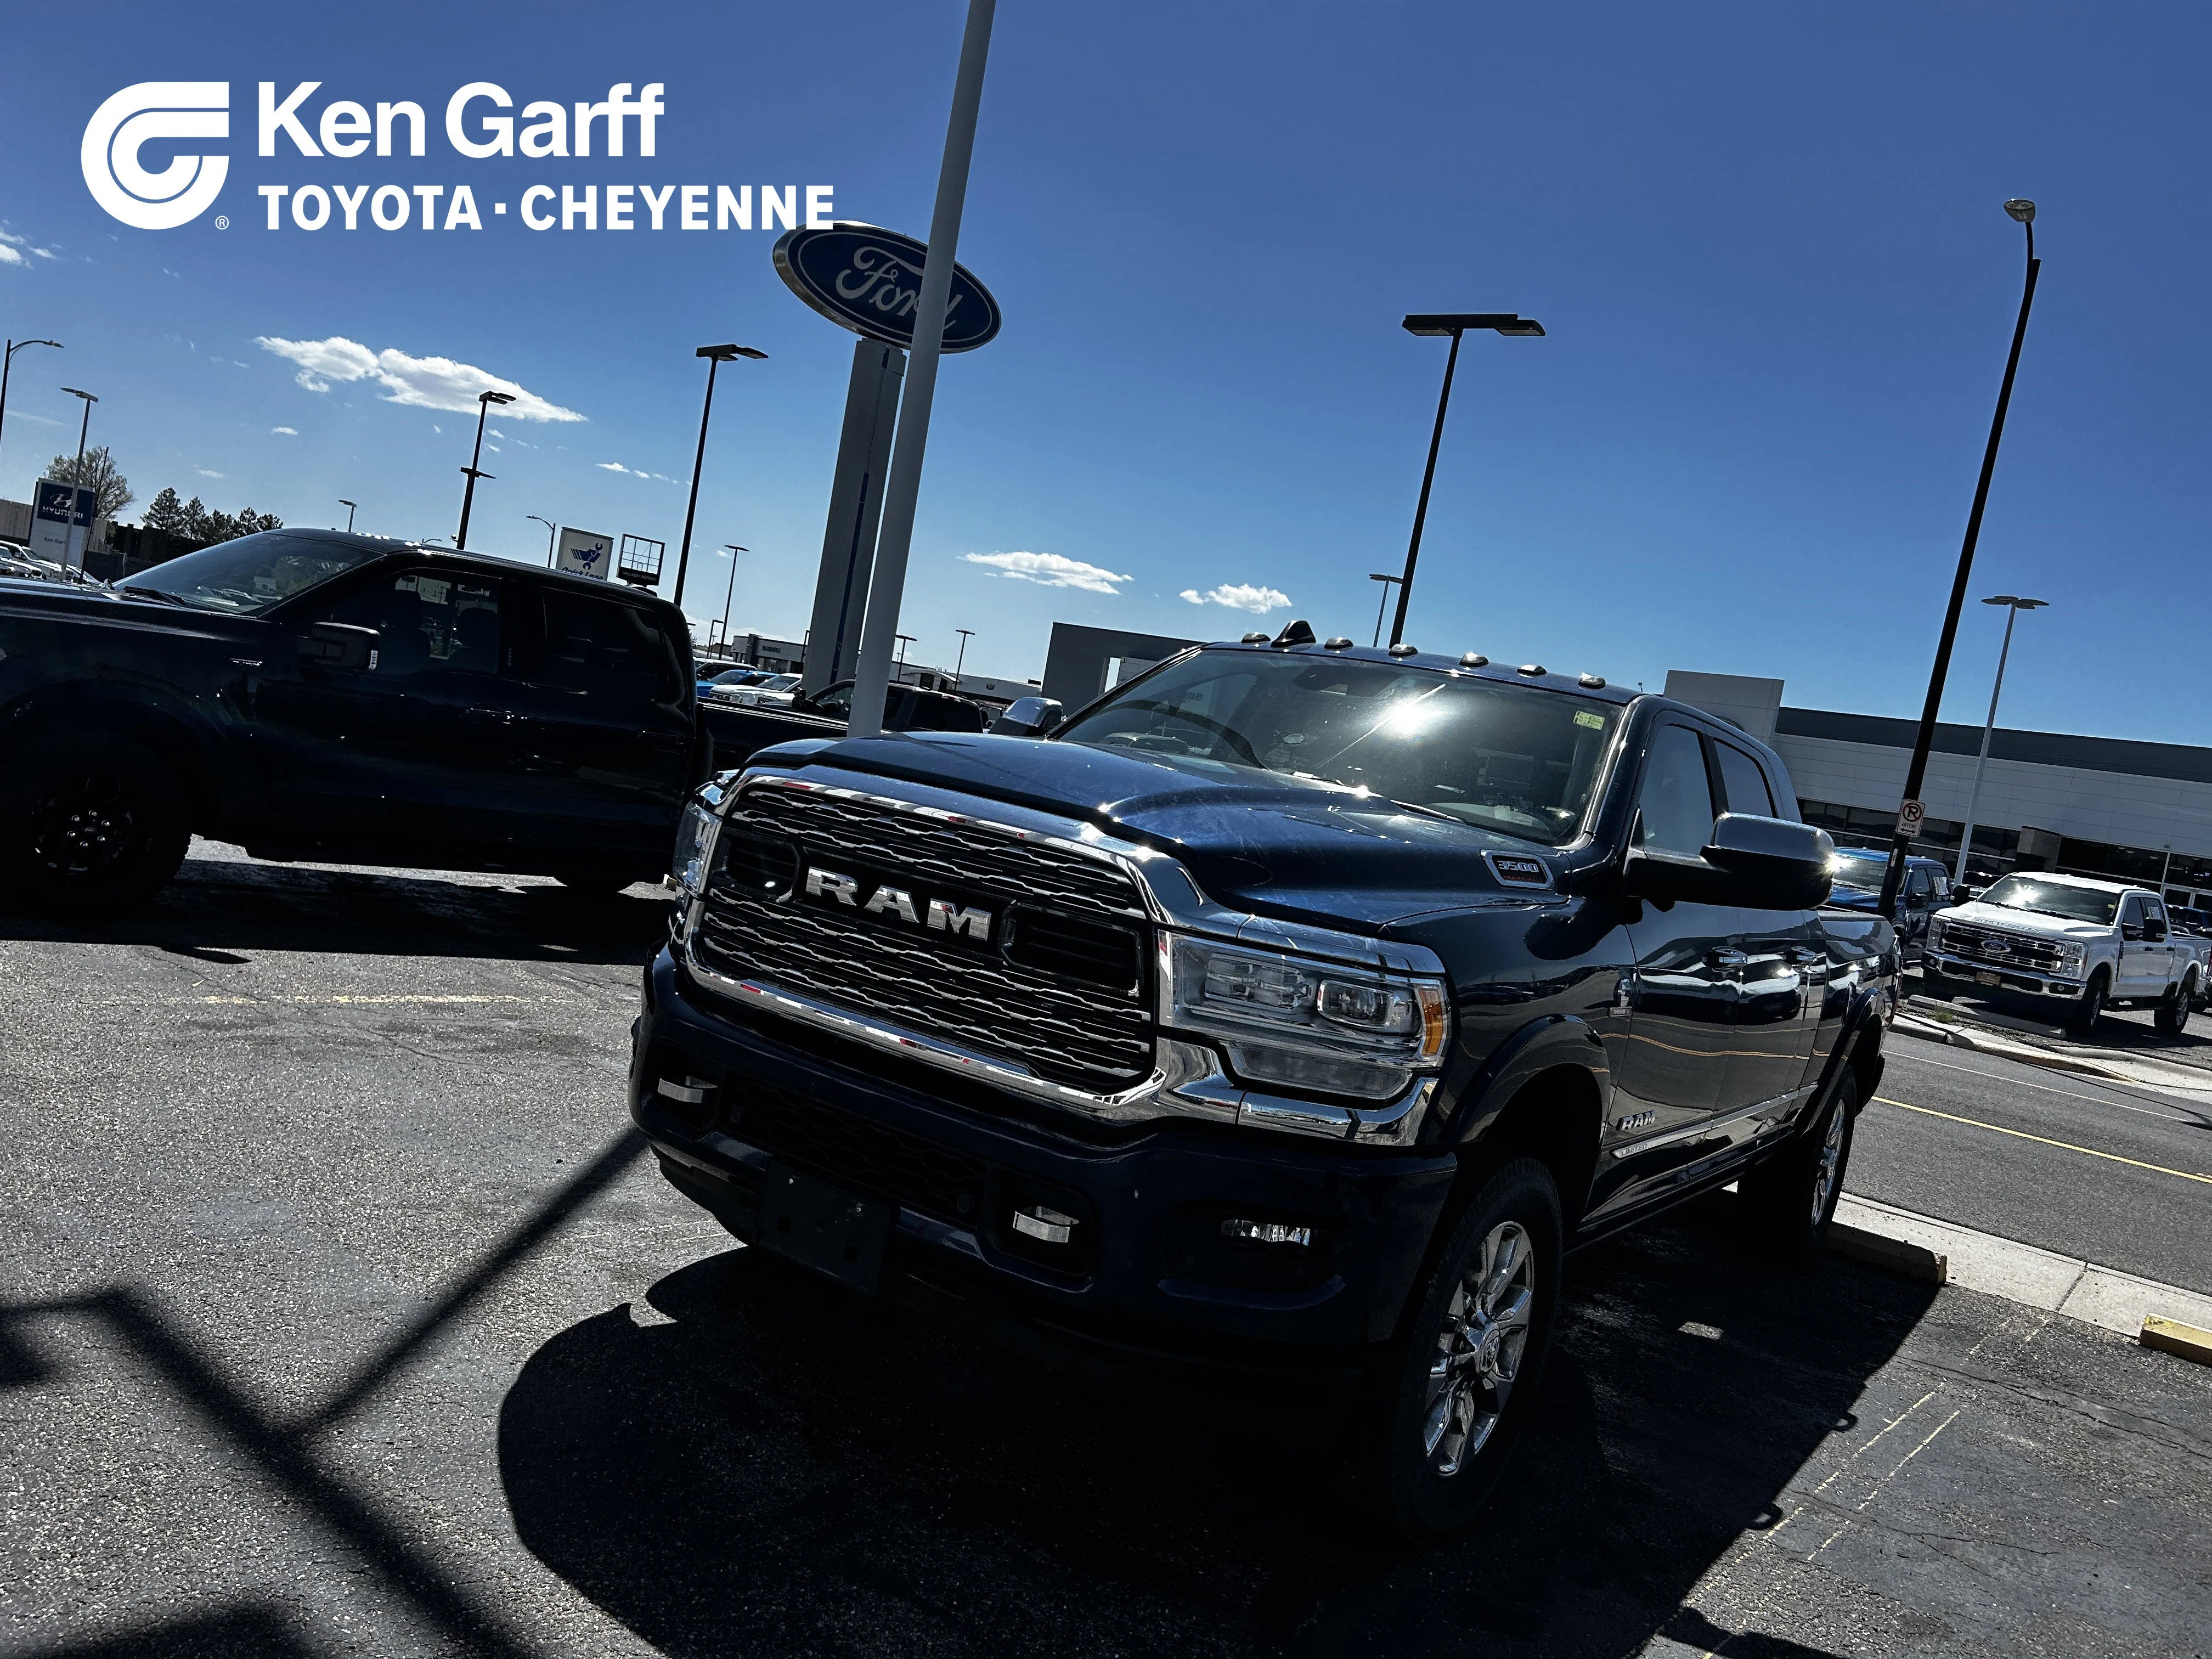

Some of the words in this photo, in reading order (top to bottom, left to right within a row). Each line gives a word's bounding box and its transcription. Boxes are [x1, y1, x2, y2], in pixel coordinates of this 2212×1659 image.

[1497, 860, 1539, 873] 3500
[805, 866, 992, 941] RAM
[1616, 1110, 1656, 1131] RAM
[1621, 1143, 1648, 1156] LIMITED
